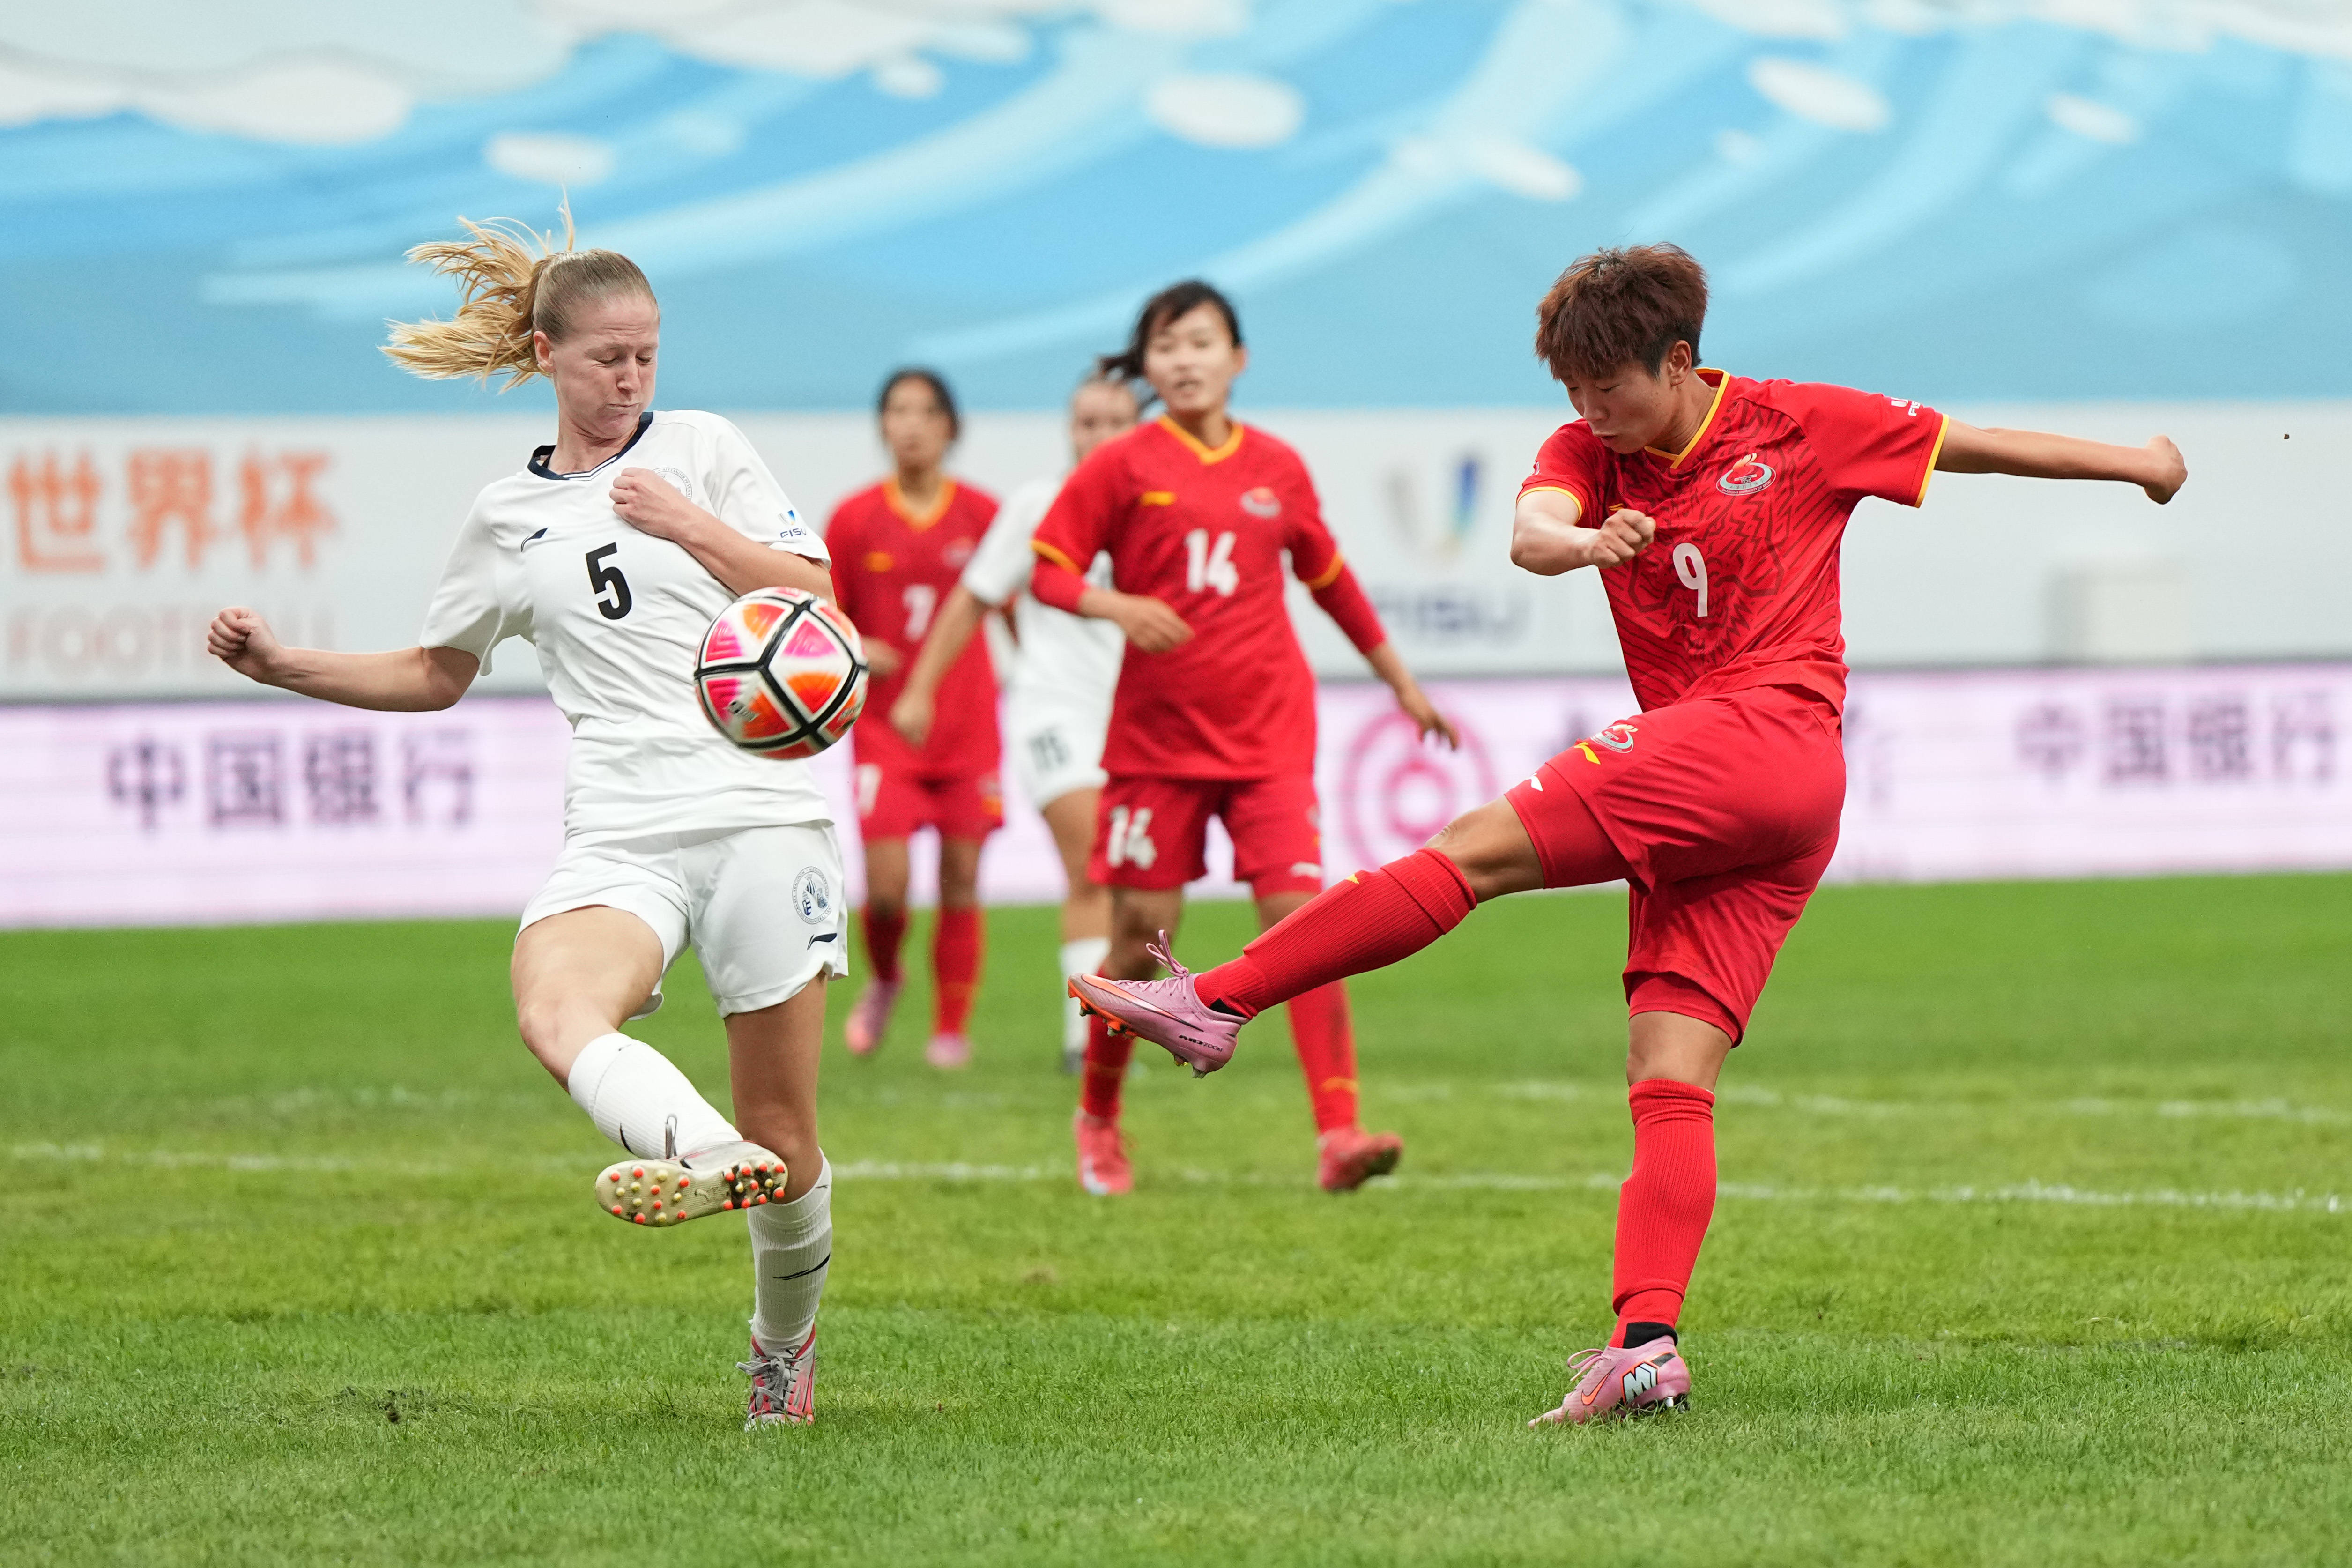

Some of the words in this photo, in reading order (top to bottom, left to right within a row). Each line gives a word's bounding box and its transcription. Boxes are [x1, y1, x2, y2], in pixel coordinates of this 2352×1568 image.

[1908, 401, 1921, 416] FIS
[8, 447, 337, 573] 世界杯
[780, 528, 807, 538] FISU
[586, 542, 632, 620] 5
[1184, 528, 1239, 597] 14
[1672, 543, 1708, 617] 9
[6, 603, 337, 677] FOOT
[2014, 690, 2337, 788] 中国银行
[105, 729, 477, 836] 中国银行
[1107, 804, 1157, 870] 14
